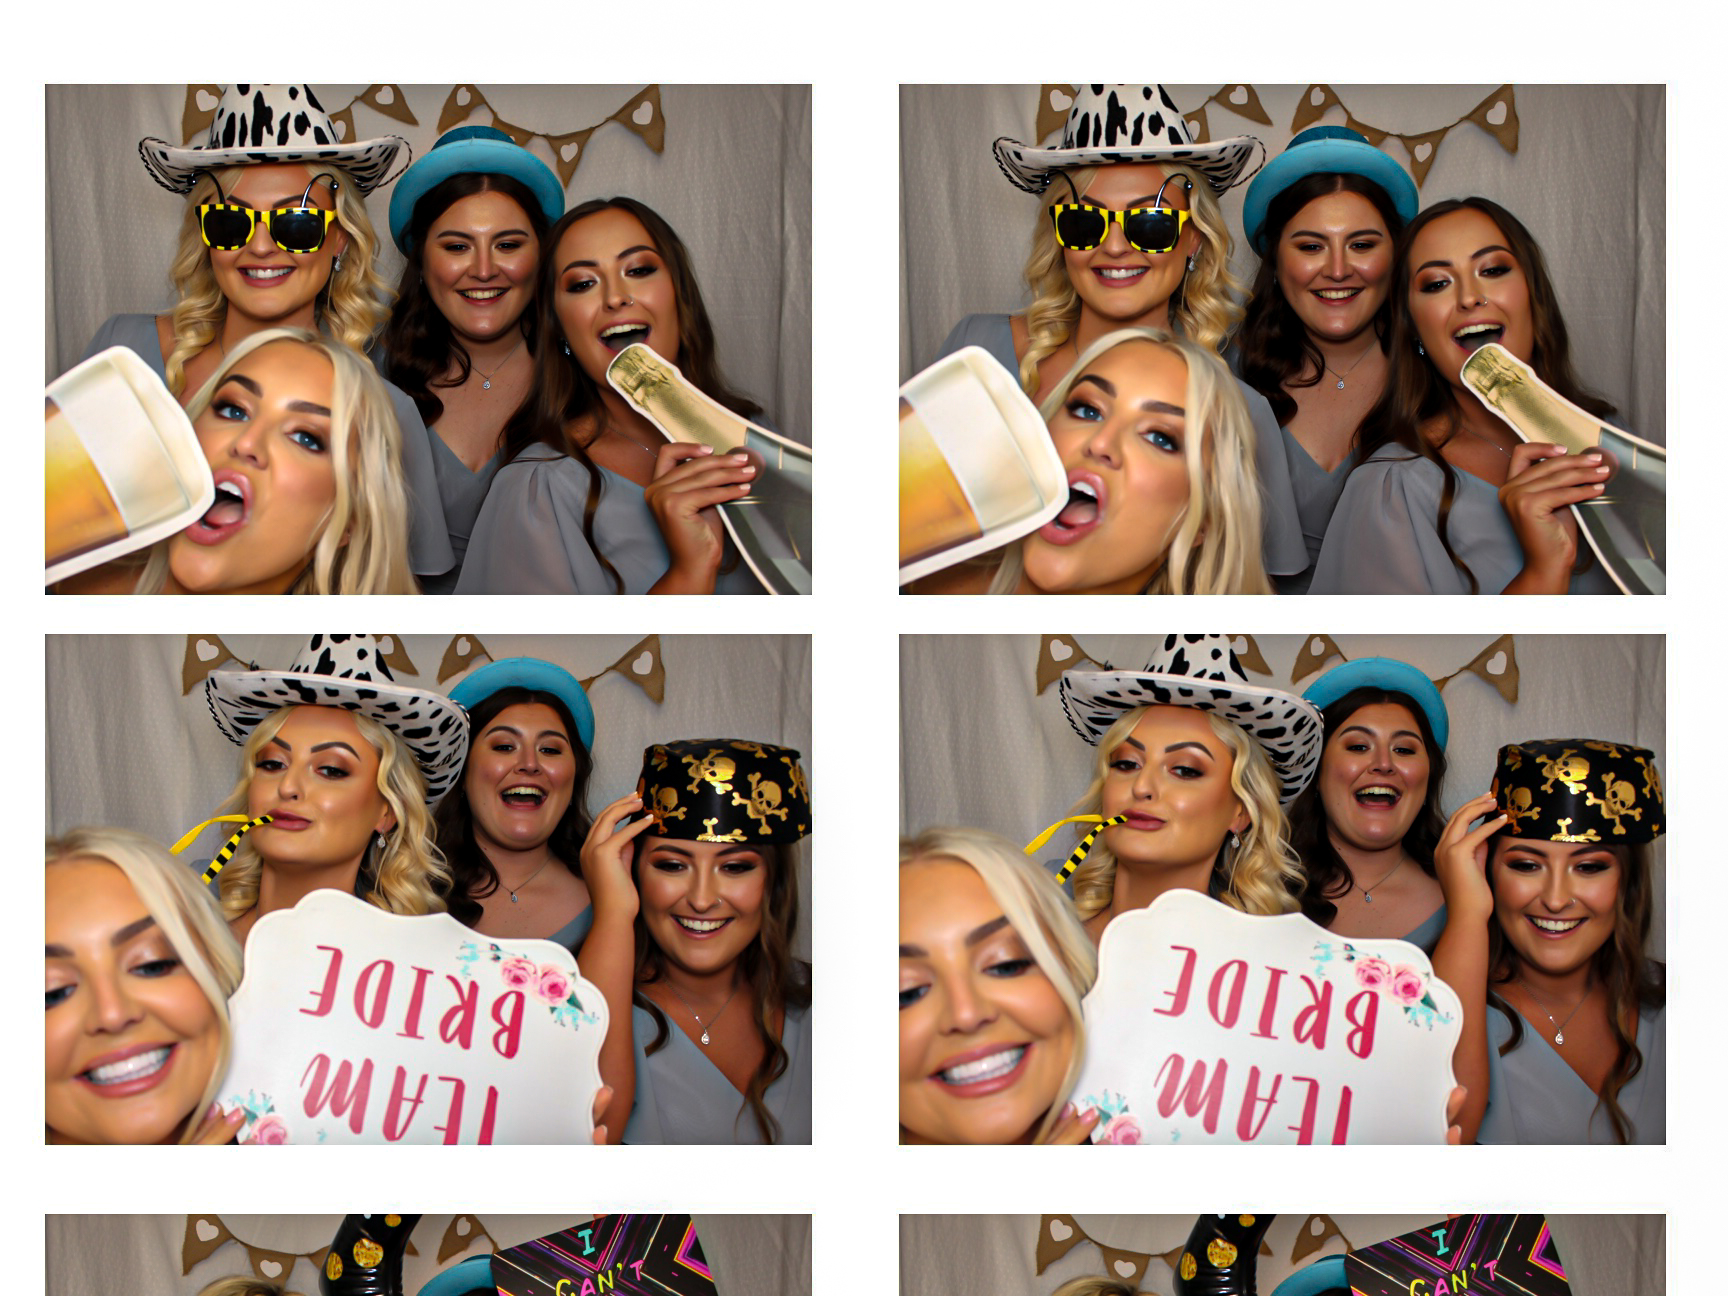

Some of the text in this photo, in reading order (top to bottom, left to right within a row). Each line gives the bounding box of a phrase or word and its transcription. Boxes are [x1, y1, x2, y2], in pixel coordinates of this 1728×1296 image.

[300, 945, 525, 1060] BRIDE
[1154, 945, 1379, 1060] BRIDE
[300, 1054, 499, 1146] TEAM
[1154, 1054, 1353, 1146] TEAM
[578, 1229, 595, 1256] I
[1432, 1229, 1449, 1256] I
